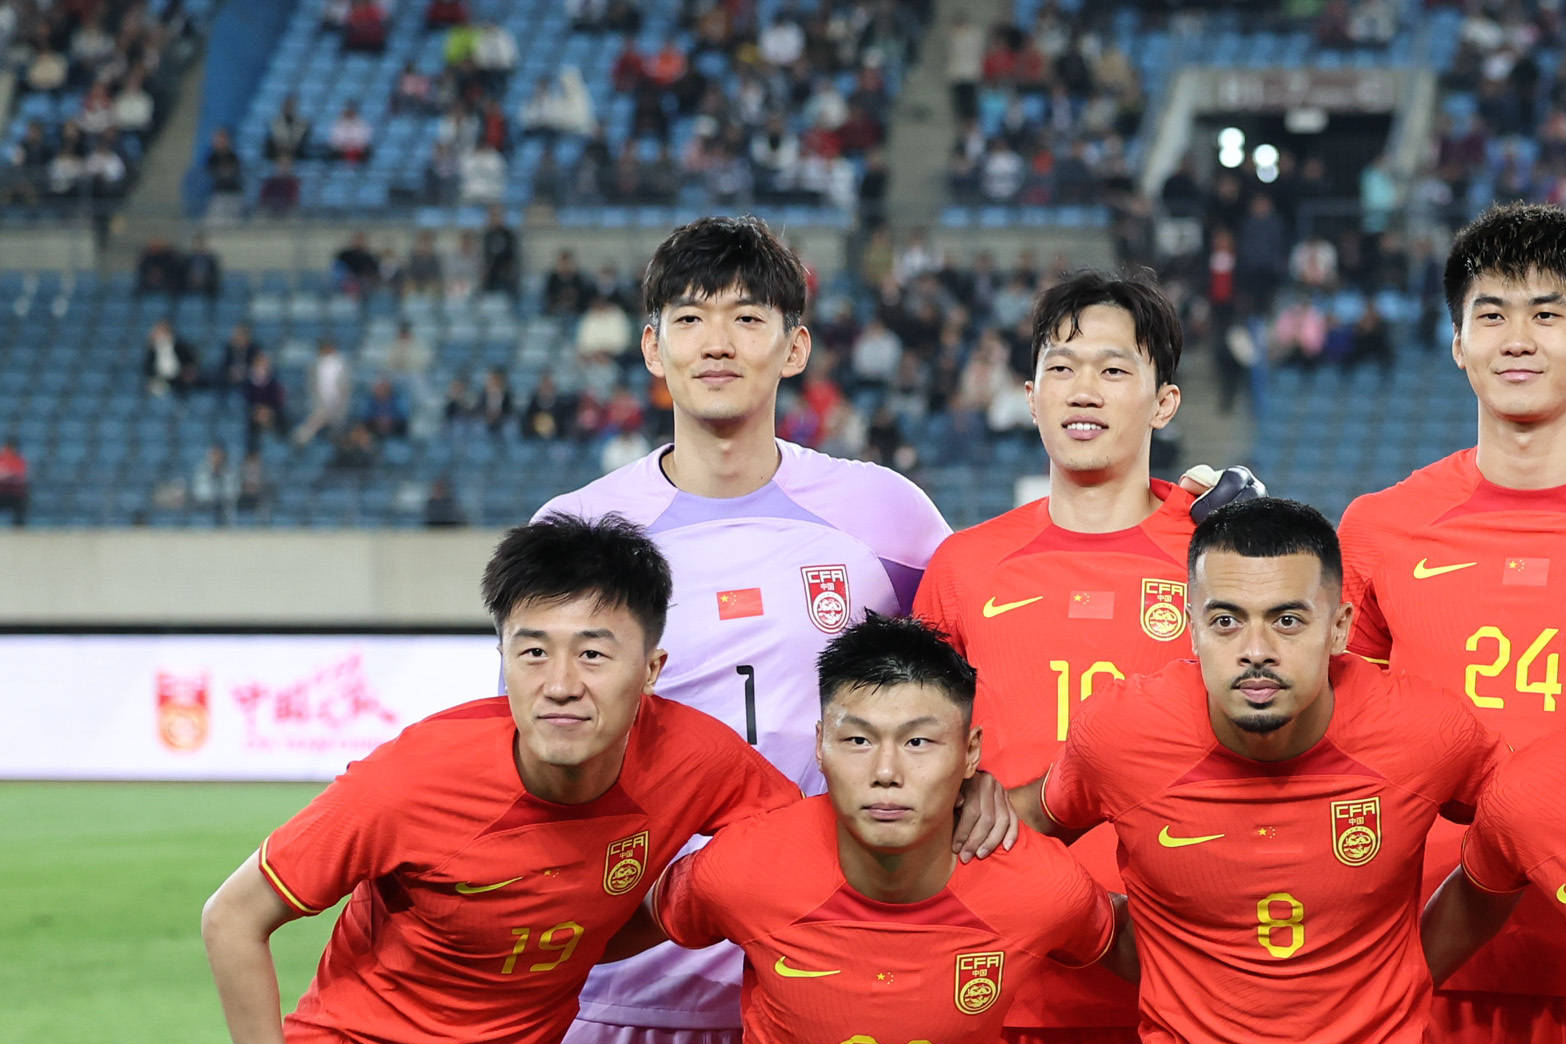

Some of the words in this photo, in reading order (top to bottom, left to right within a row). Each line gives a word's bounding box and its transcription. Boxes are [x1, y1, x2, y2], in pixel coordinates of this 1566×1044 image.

[807, 570, 844, 583] CFA
[1145, 581, 1184, 596] CFA
[1465, 626, 1562, 712] 24
[736, 665, 757, 745] 1
[1335, 802, 1376, 818] CFA
[610, 836, 644, 855] CFA
[1257, 893, 1305, 958] 8
[501, 921, 584, 974] 19
[960, 956, 999, 970] CFA
